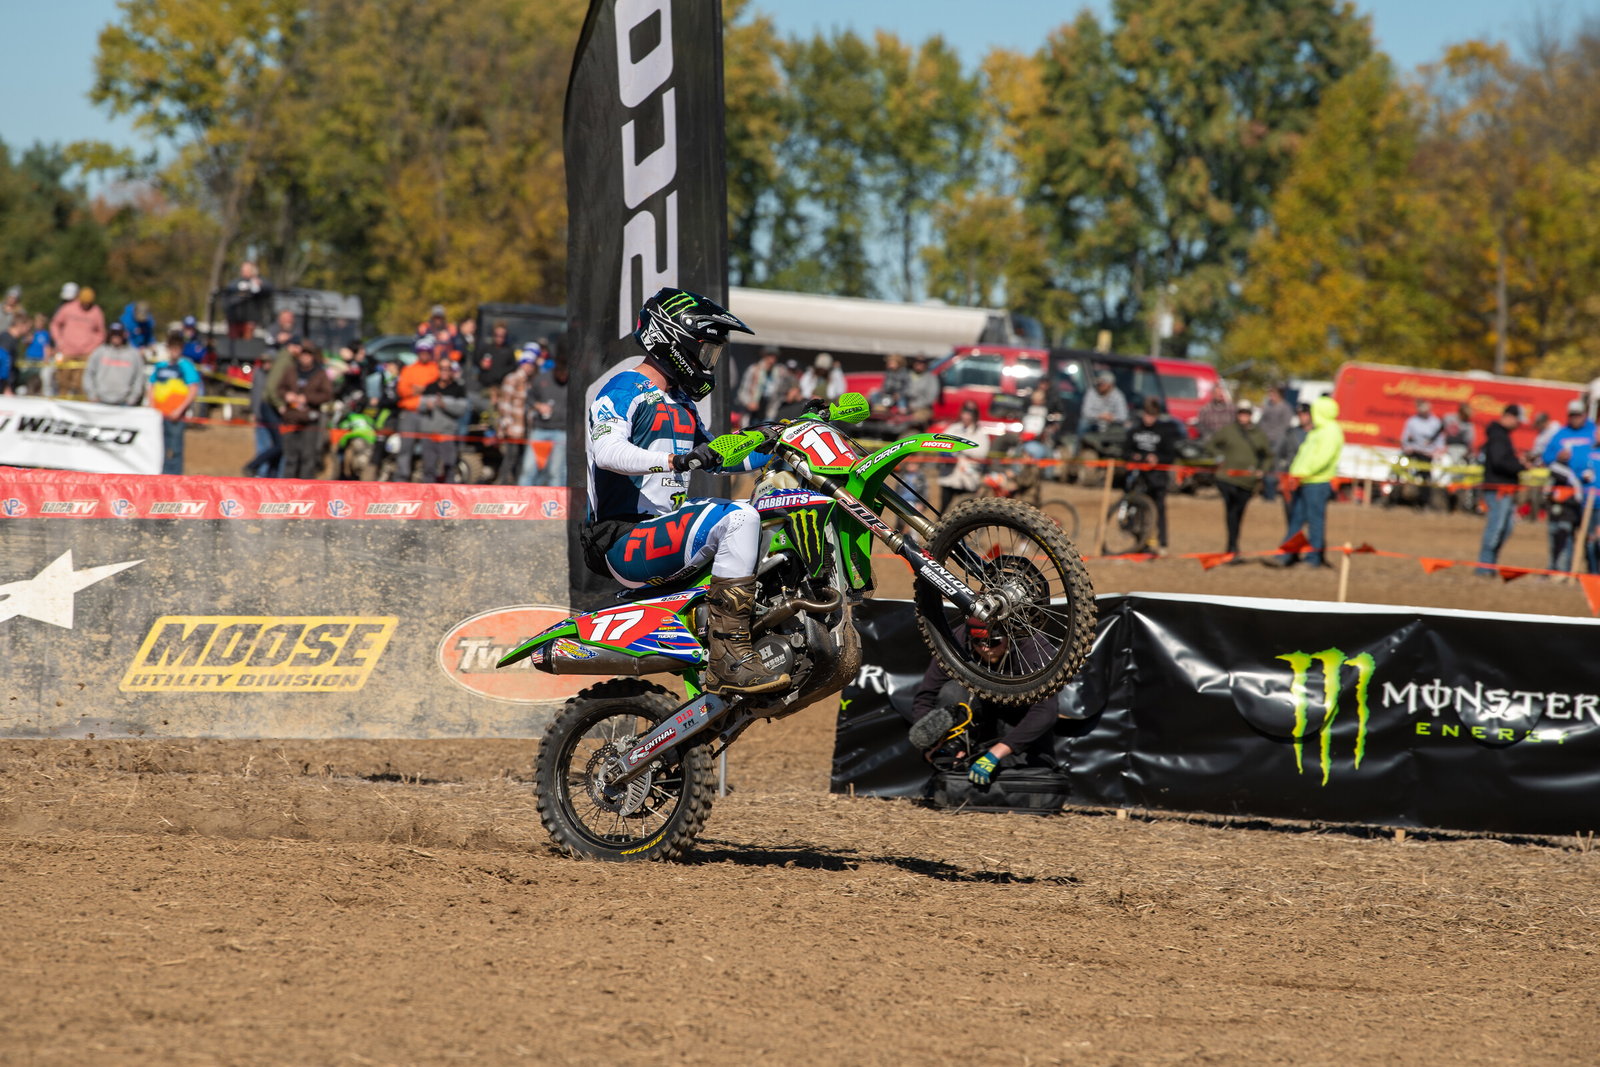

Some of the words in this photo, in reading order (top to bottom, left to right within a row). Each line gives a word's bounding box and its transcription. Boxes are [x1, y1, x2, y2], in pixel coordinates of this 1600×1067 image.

[670, 346, 695, 376] MONSTER
[799, 424, 852, 466] 17
[922, 441, 952, 449] MOTUL
[757, 493, 809, 511] BABBITT'S
[624, 512, 694, 562] FLY
[917, 552, 975, 596] DUNLOP
[590, 609, 646, 641] 17
[142, 623, 385, 667] MOOSE
[762, 653, 787, 670] NSON
[130, 674, 233, 687] UTILITY
[237, 674, 363, 687] DIVISION
[1382, 678, 1600, 726] MONSTER
